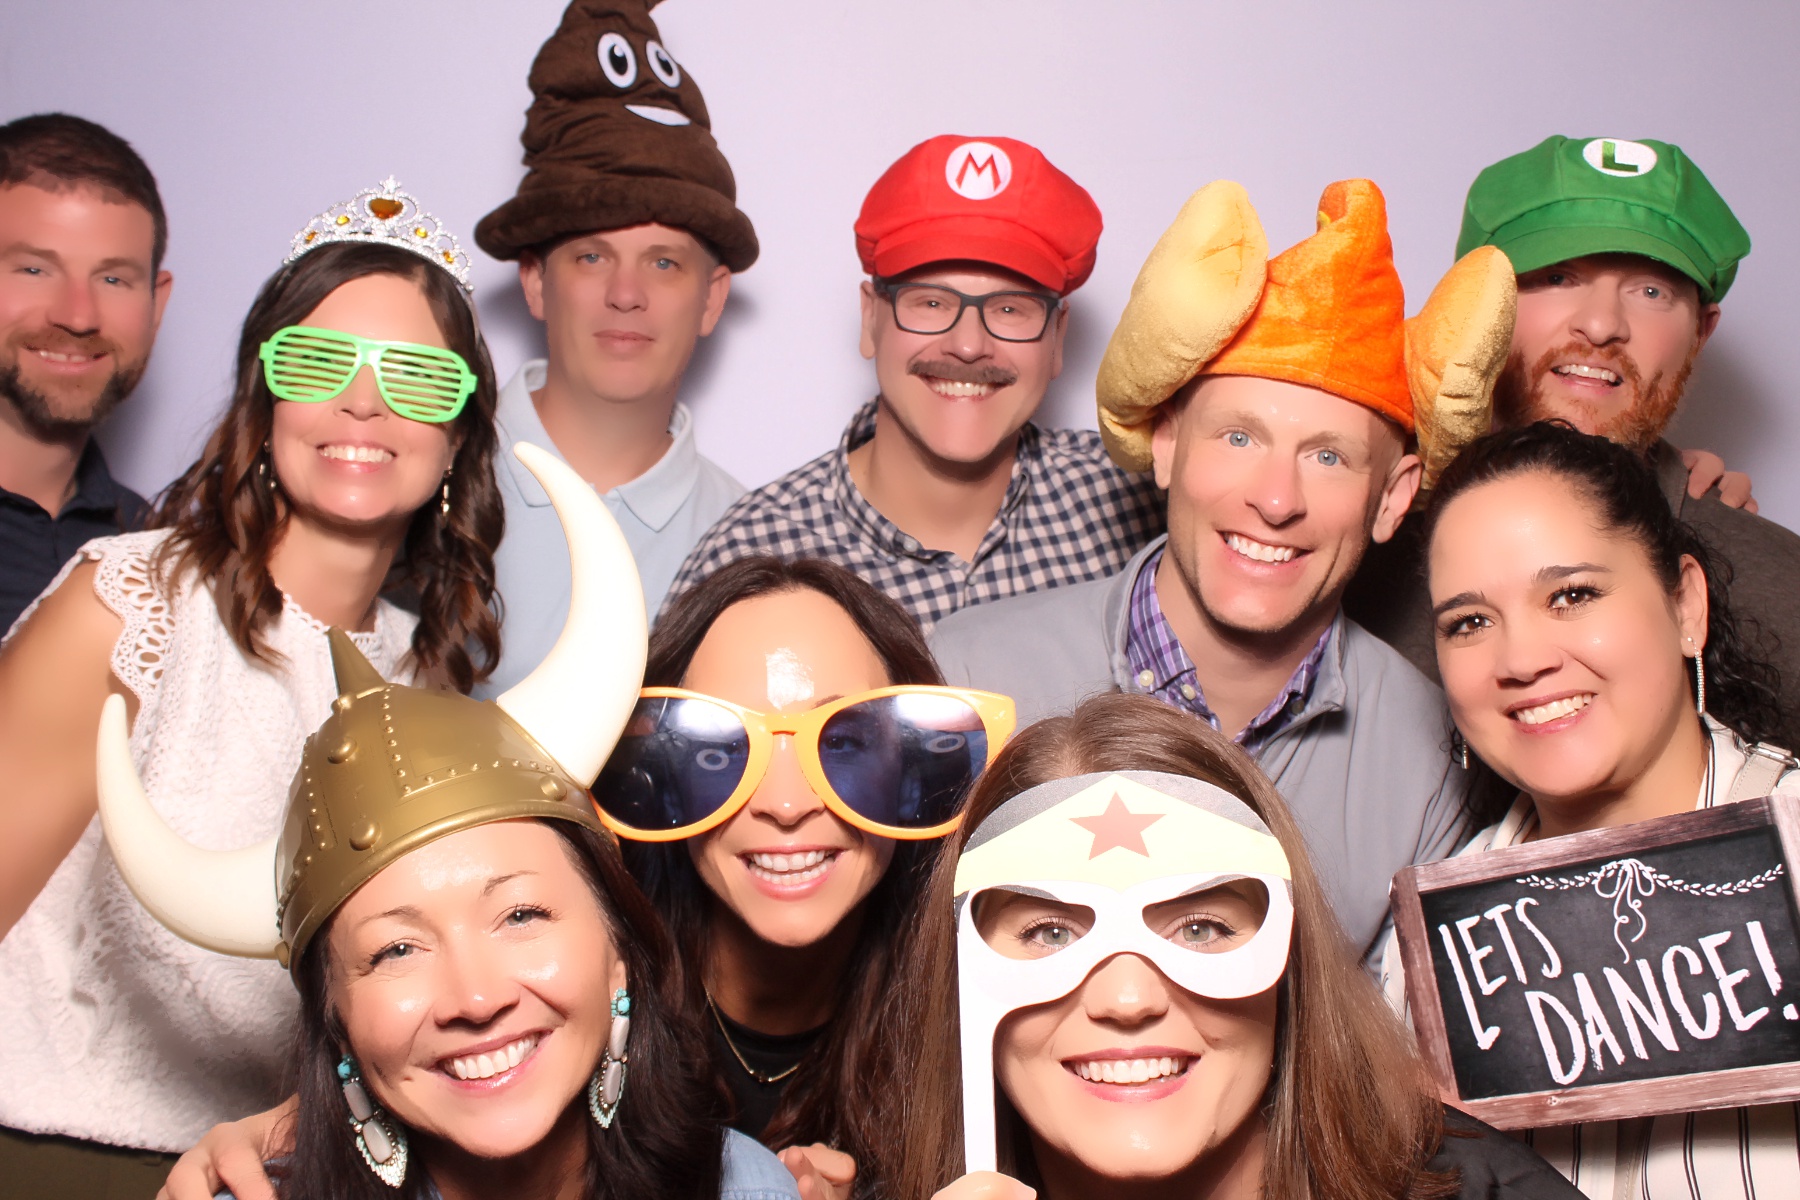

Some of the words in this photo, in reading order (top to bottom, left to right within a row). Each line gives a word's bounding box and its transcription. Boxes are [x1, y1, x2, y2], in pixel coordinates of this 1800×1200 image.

[955, 151, 1002, 192] M
[1602, 141, 1639, 173] L
[1438, 897, 1562, 1051] LETS
[1524, 921, 1799, 1085] DANCE!
